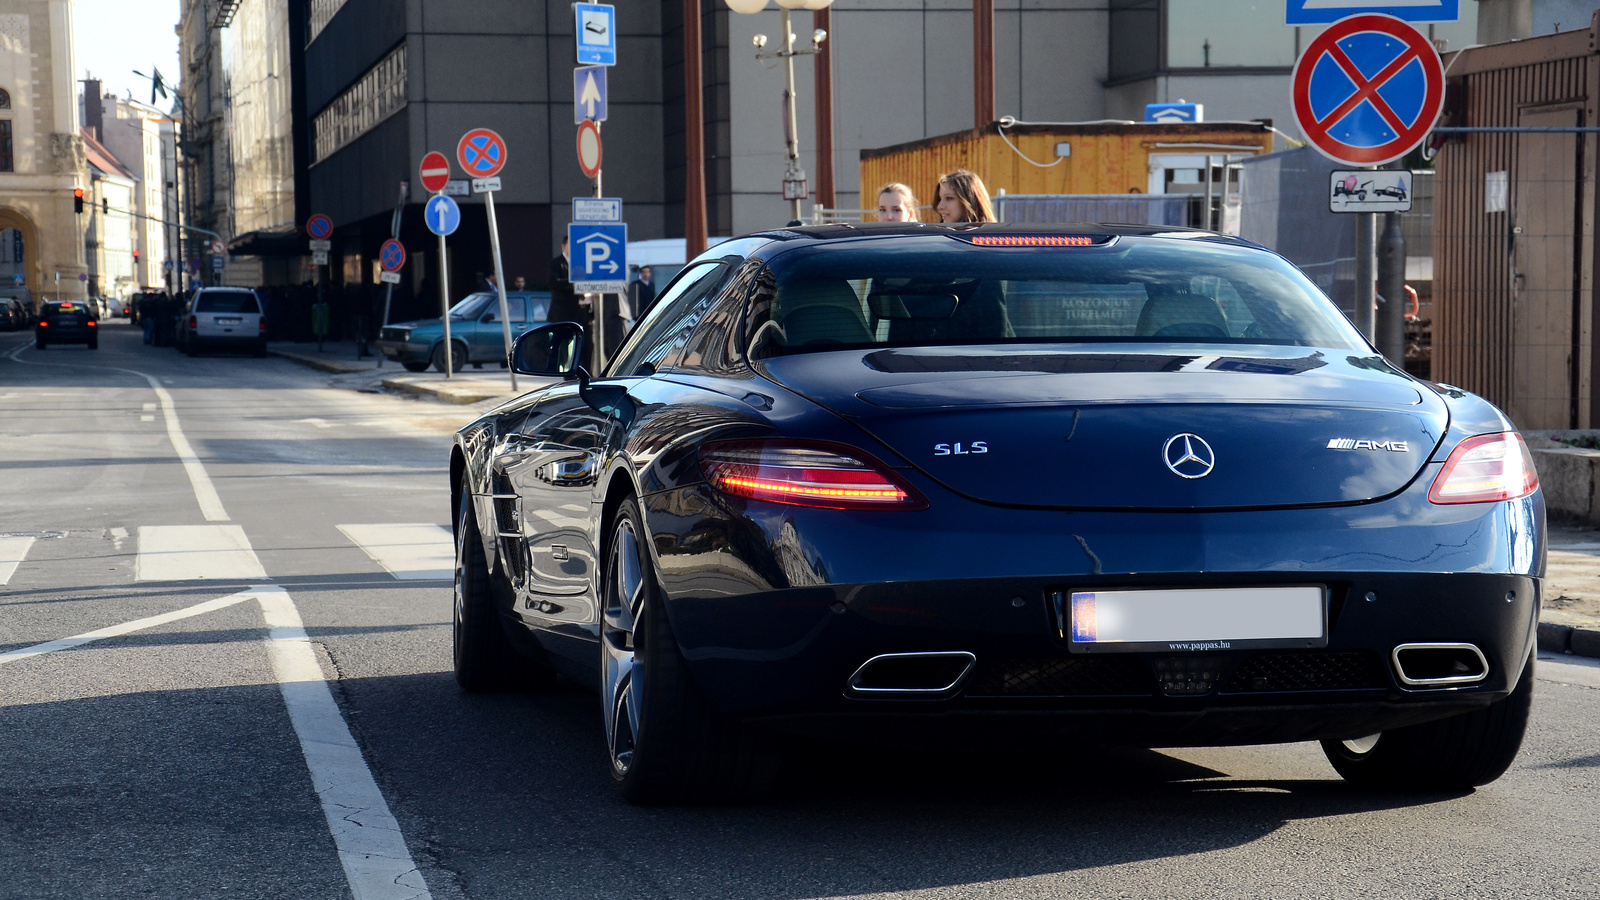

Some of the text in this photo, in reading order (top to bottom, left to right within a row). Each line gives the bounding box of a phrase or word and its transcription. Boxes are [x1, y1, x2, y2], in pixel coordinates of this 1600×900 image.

[585, 242, 611, 274] P
[934, 441, 988, 456] SLS
[1353, 440, 1409, 452] AMG
[1169, 640, 1231, 651] www.pappas.hu
